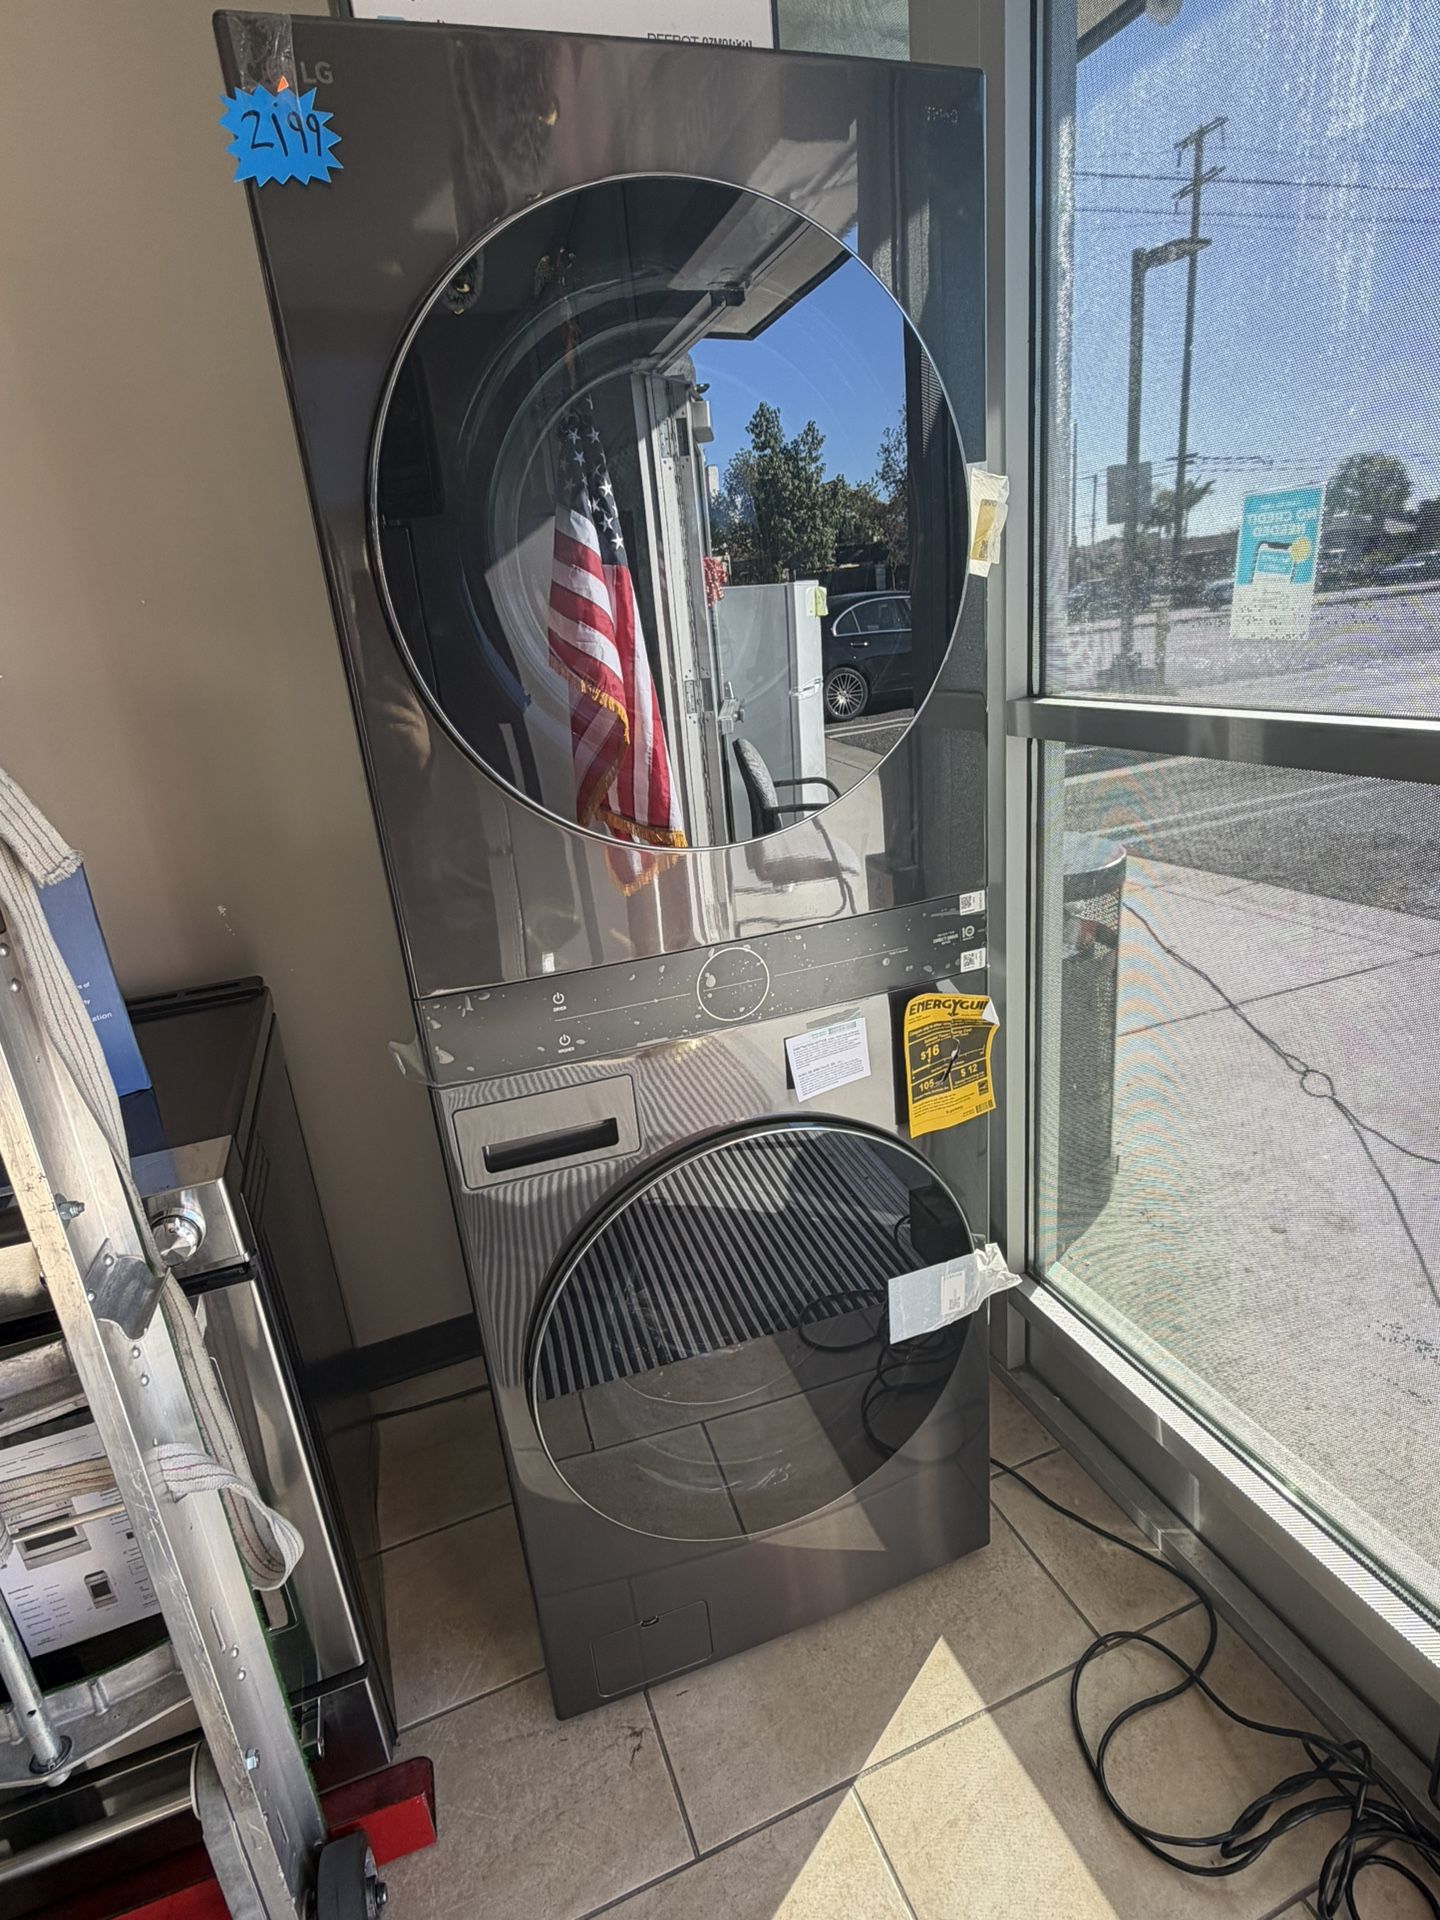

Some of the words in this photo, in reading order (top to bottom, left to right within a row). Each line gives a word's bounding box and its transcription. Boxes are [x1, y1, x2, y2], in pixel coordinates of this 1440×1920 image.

[300, 61, 334, 84] LG
[241, 110, 322, 157] 2199
[909, 999, 989, 1017] ENERGYGUI
